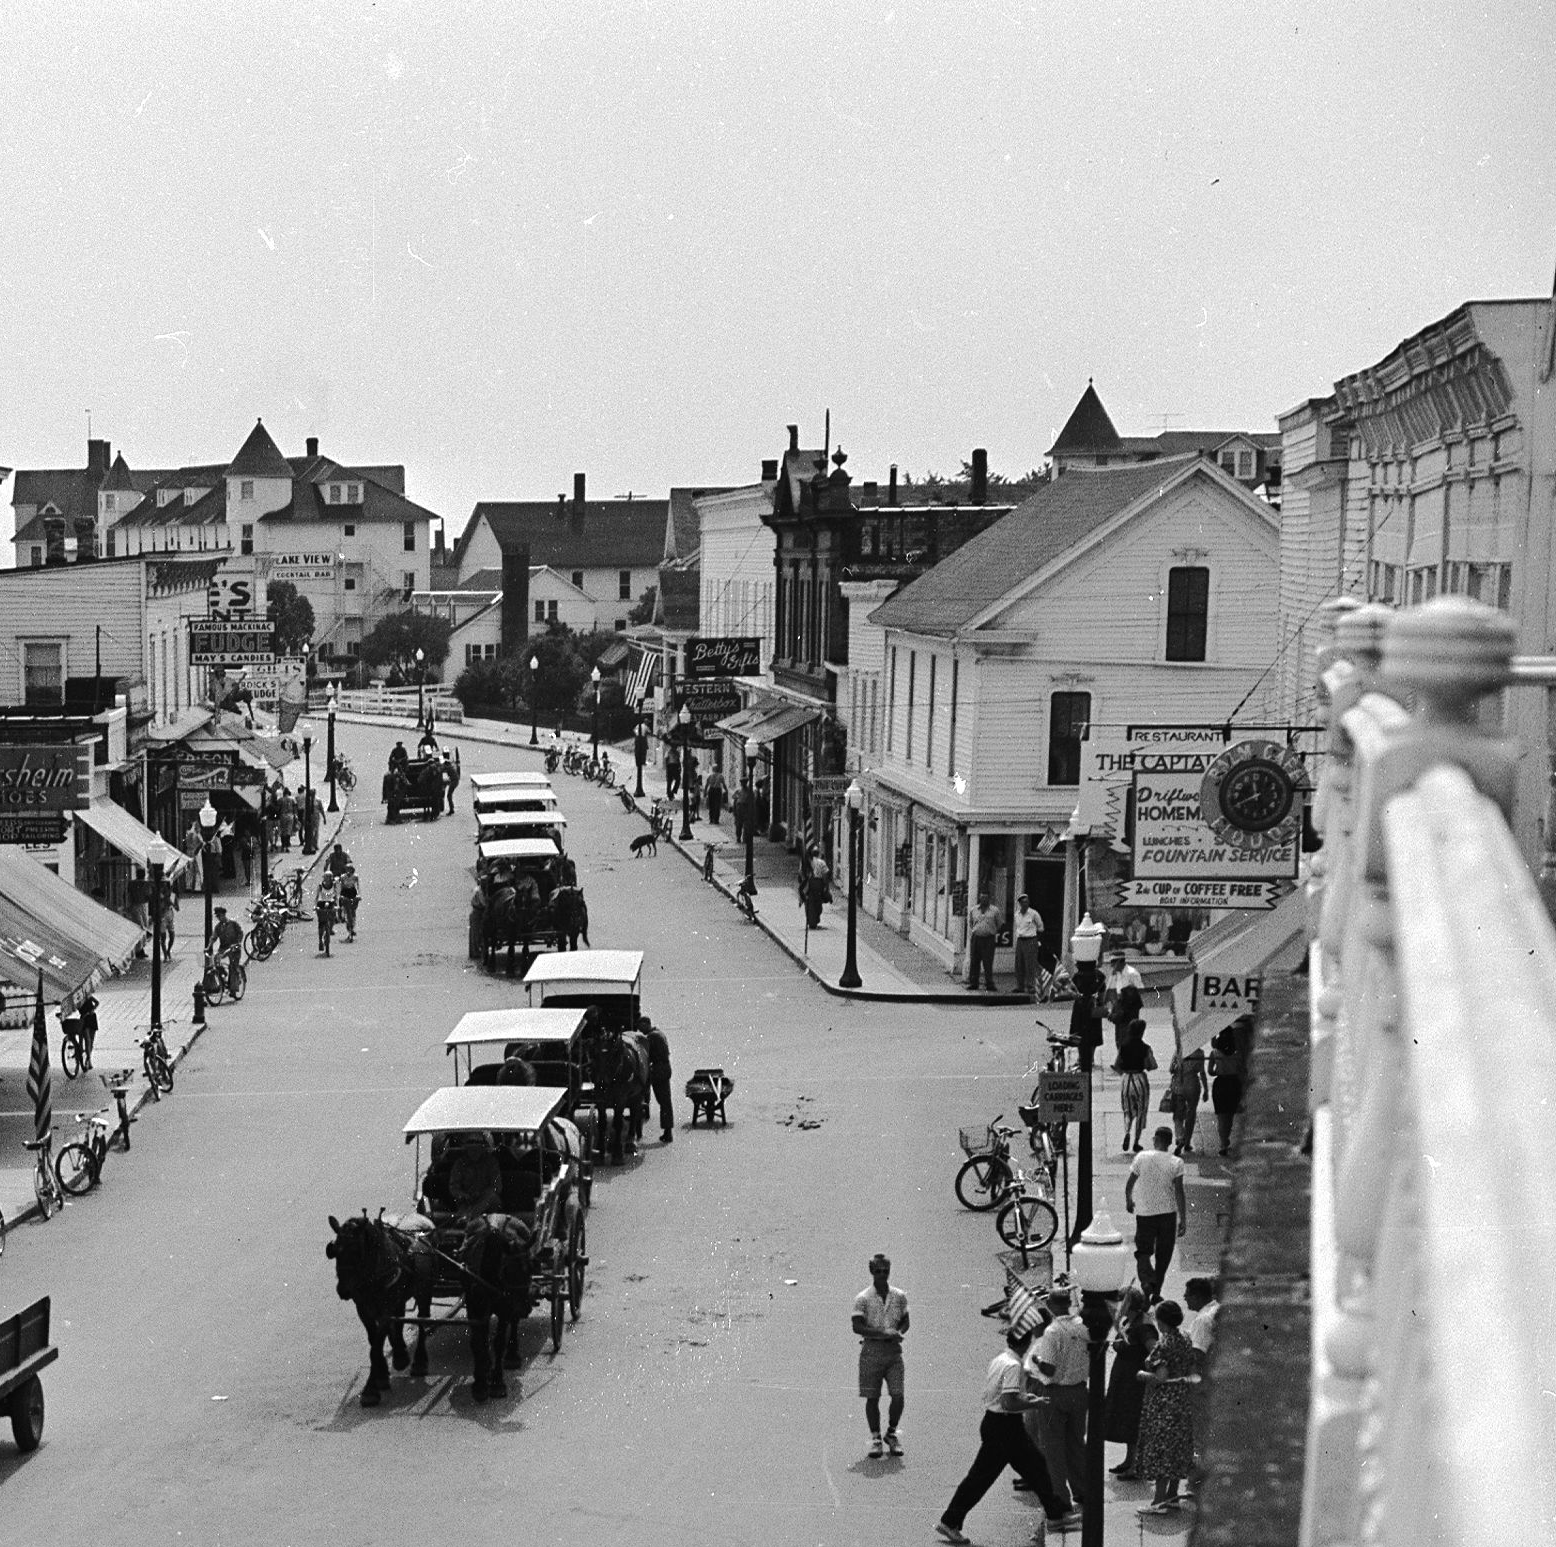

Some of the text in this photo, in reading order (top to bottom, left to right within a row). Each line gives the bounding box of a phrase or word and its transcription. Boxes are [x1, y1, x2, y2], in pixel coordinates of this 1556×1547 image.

[303, 554, 331, 564] VIEW
[194, 623, 271, 631] FAMOUS MACKINAC
[195, 633, 271, 652] FUDGE
[231, 654, 272, 662] CANDIES
[692, 642, 740, 666] Betty's
[254, 689, 276, 698] UDGE
[674, 683, 730, 694] WESTERN
[1134, 732, 1223, 741] RESTAURANT
[1095, 754, 1218, 771] THE CAPTAI
[1137, 786, 1201, 807] Driftwo
[1137, 806, 1202, 821] HOMEM
[1143, 836, 1191, 846] LUNCHES
[1141, 848, 1292, 863] FOUNTAIN SERVICE
[1153, 882, 1172, 895] CUP
[1184, 883, 1226, 896] COFFEE
[1229, 884, 1263, 897] FREE
[1179, 896, 1229, 905] INFORMATION
